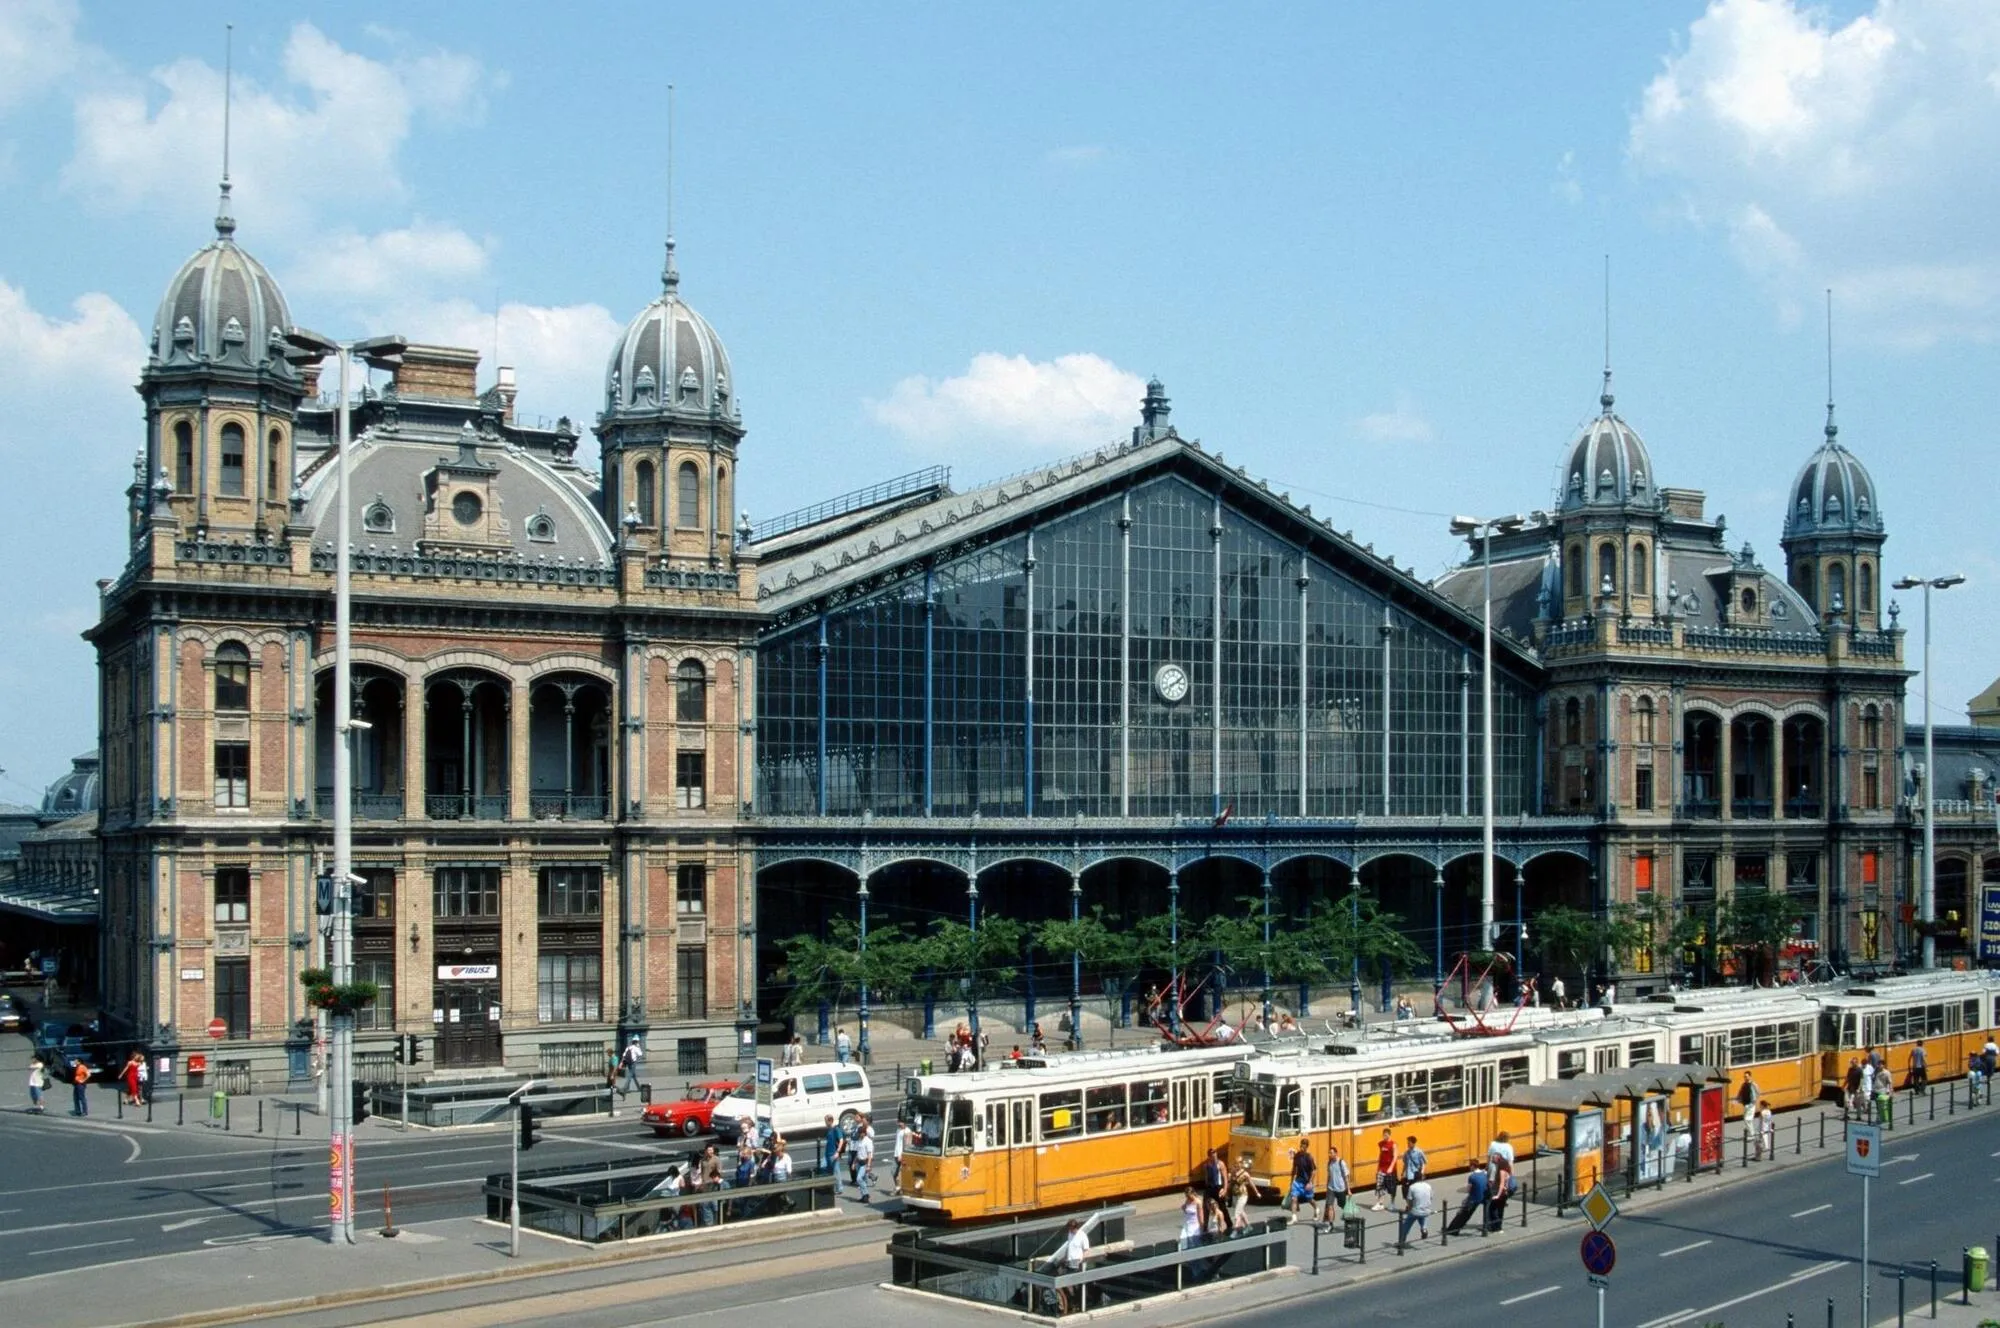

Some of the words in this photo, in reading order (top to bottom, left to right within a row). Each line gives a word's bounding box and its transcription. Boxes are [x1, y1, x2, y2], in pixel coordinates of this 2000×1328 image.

[318, 881, 330, 901] M
[1984, 920, 2000, 930] SZO
[464, 966, 490, 974] IBUSZ
[911, 1080, 917, 1094] 6
